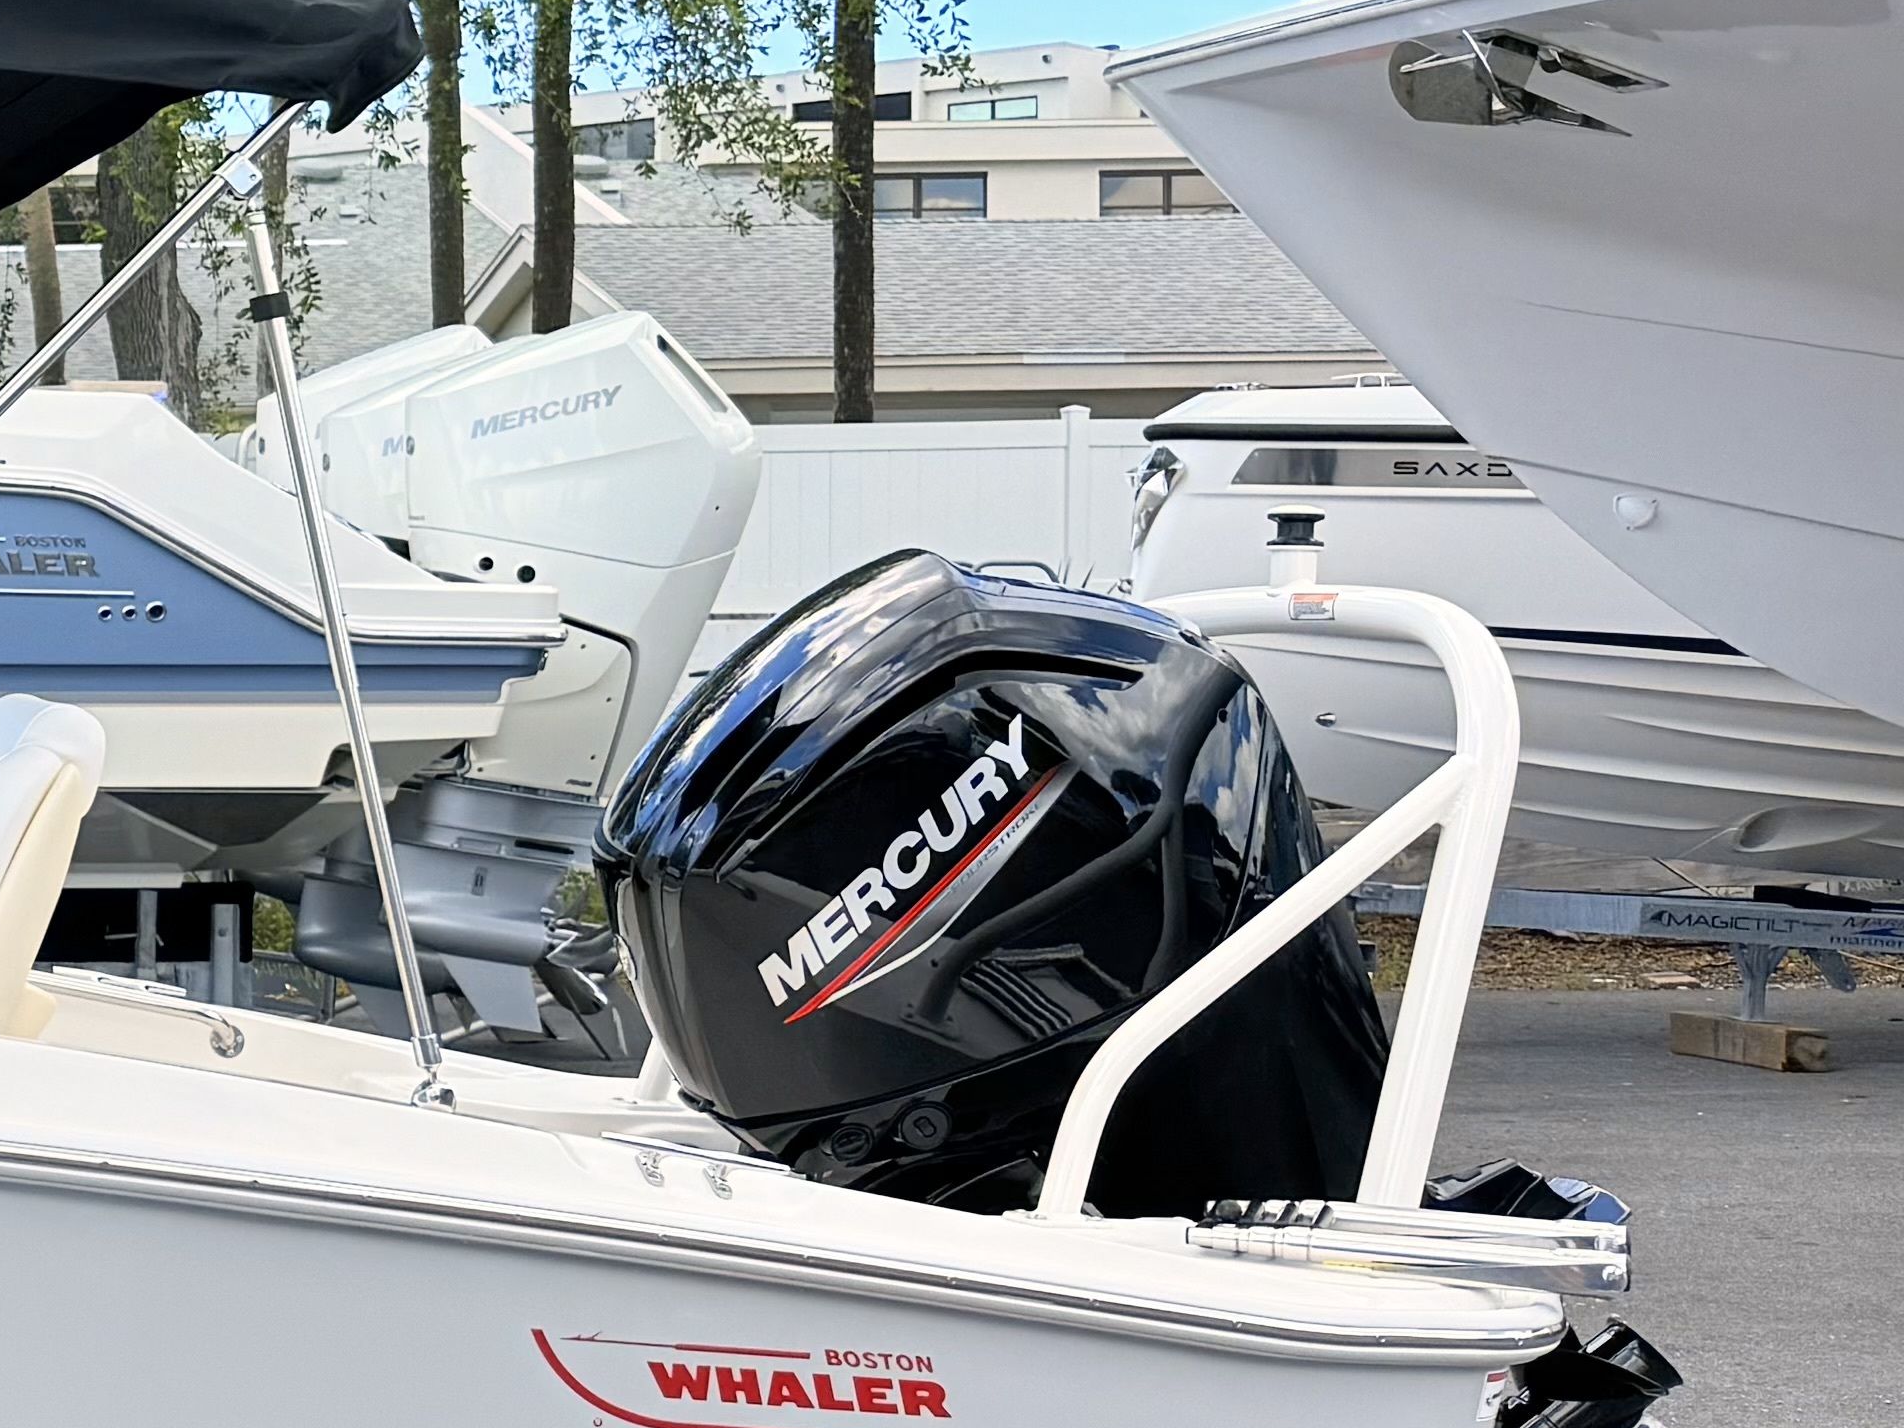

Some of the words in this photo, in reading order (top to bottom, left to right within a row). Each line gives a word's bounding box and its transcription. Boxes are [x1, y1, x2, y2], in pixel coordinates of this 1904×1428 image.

[471, 384, 623, 440] MERCURY
[14, 534, 86, 549] BOSTON
[757, 713, 1030, 1007] MERCURY
[1666, 913, 1801, 934] MAGICTILT
[824, 1349, 934, 1373] BOSTON
[646, 1360, 953, 1419] WHALER
